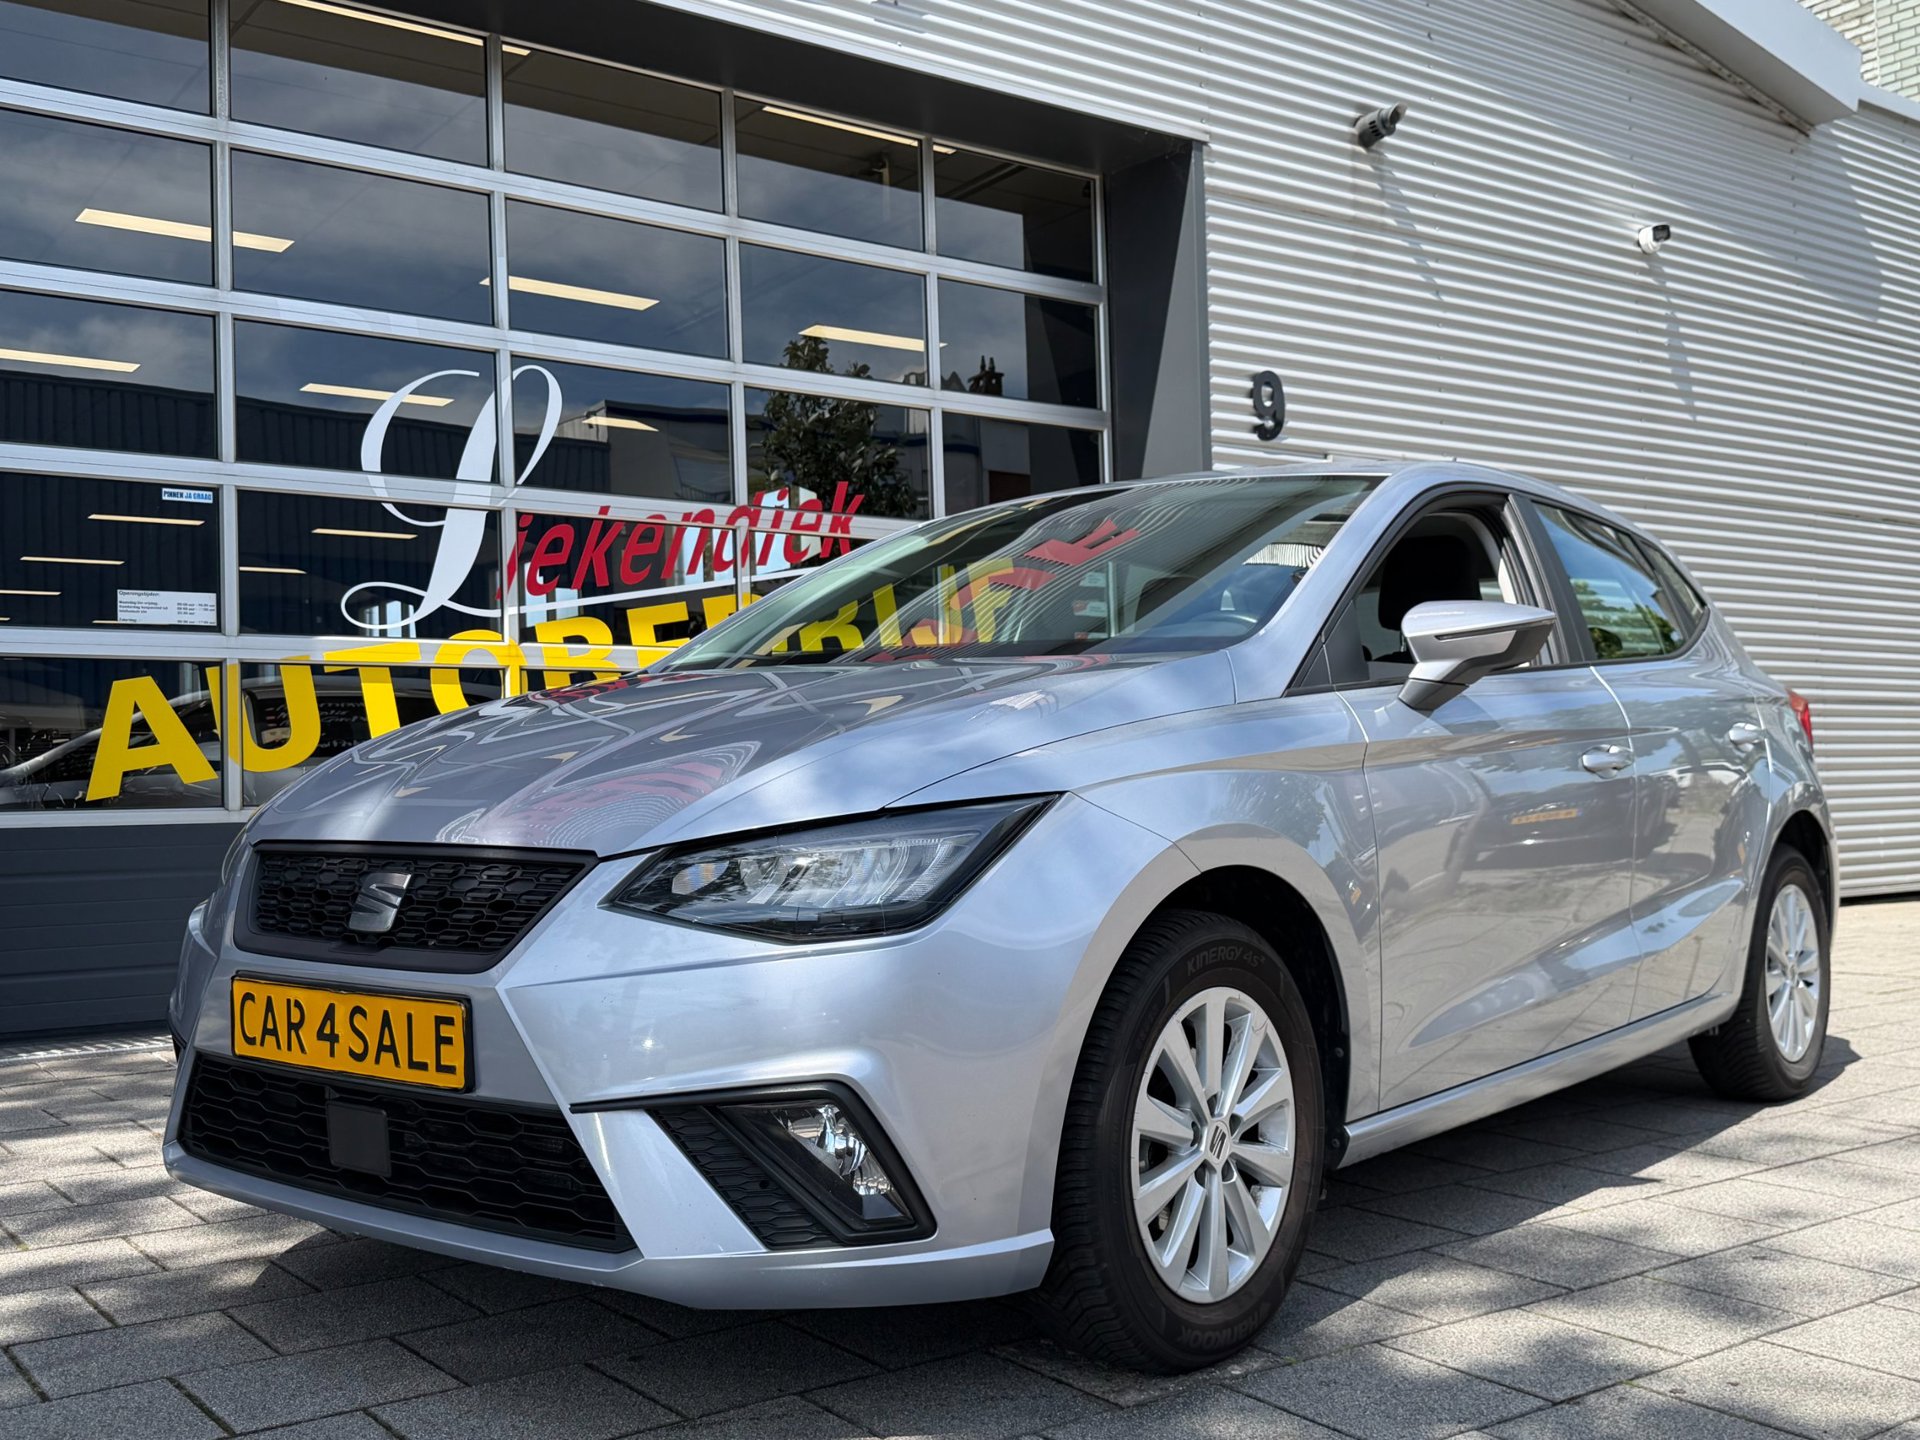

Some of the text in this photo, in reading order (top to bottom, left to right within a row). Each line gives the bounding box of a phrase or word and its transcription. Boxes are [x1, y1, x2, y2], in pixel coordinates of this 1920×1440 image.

[1251, 370, 1285, 441] 9
[184, 491, 193, 500] JA
[1186, 946, 1243, 976] KINERGY
